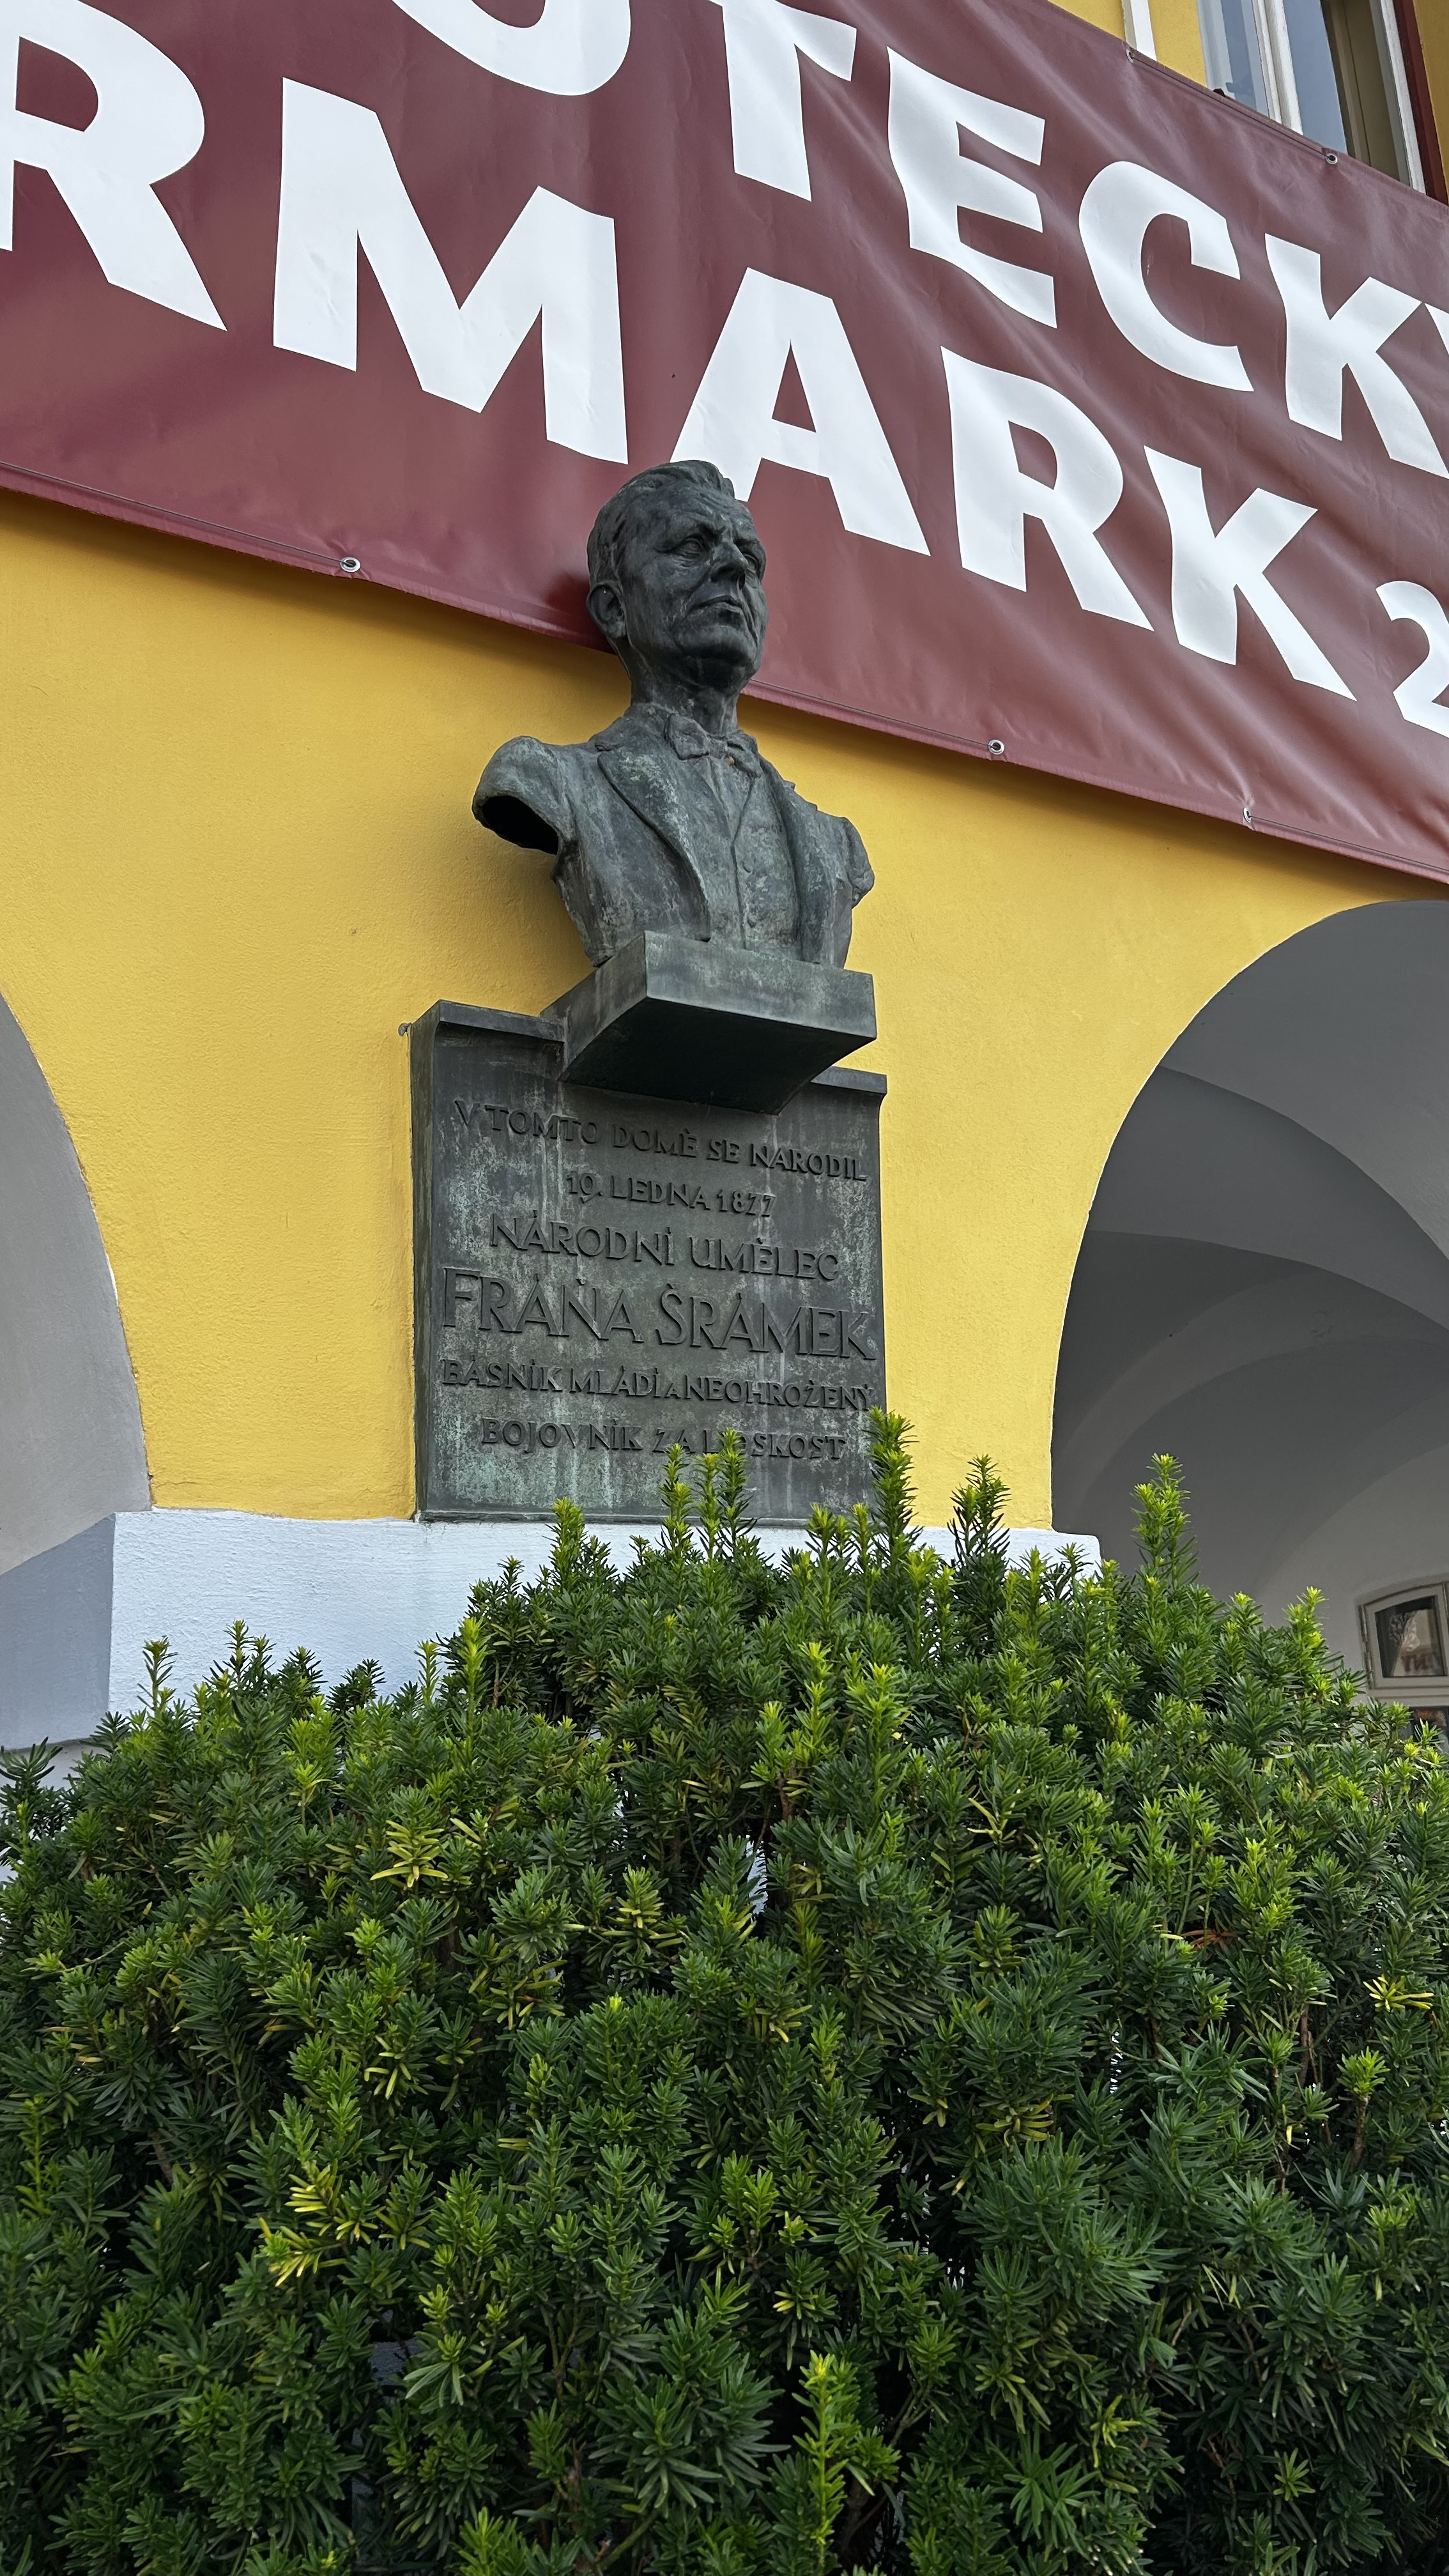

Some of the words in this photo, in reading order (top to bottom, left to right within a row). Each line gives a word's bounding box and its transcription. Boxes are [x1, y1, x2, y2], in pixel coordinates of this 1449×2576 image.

[454, 1100, 480, 1126] V
[484, 1104, 601, 1144] TOMTO
[612, 1124, 698, 1158] DOMĚ
[707, 1137, 740, 1163] SE
[749, 1142, 868, 1181] NARODIL
[565, 1171, 604, 1204] 19.
[610, 1175, 710, 1211] LEDNA
[716, 1189, 777, 1217] 1877
[490, 1209, 675, 1266] NÁRODNÍ
[689, 1236, 840, 1280] UMĚLEC
[443, 1266, 645, 1343] FRÁŇA
[655, 1283, 877, 1360] ŠRÁMEK
[441, 1355, 563, 1392] BÁSNÍK
[569, 1365, 662, 1397] MLÁDÍ
[684, 1374, 875, 1411] NEOHROŽENÝ
[481, 1417, 643, 1454] BOJOVNÍK
[652, 1429, 696, 1454] ZA
